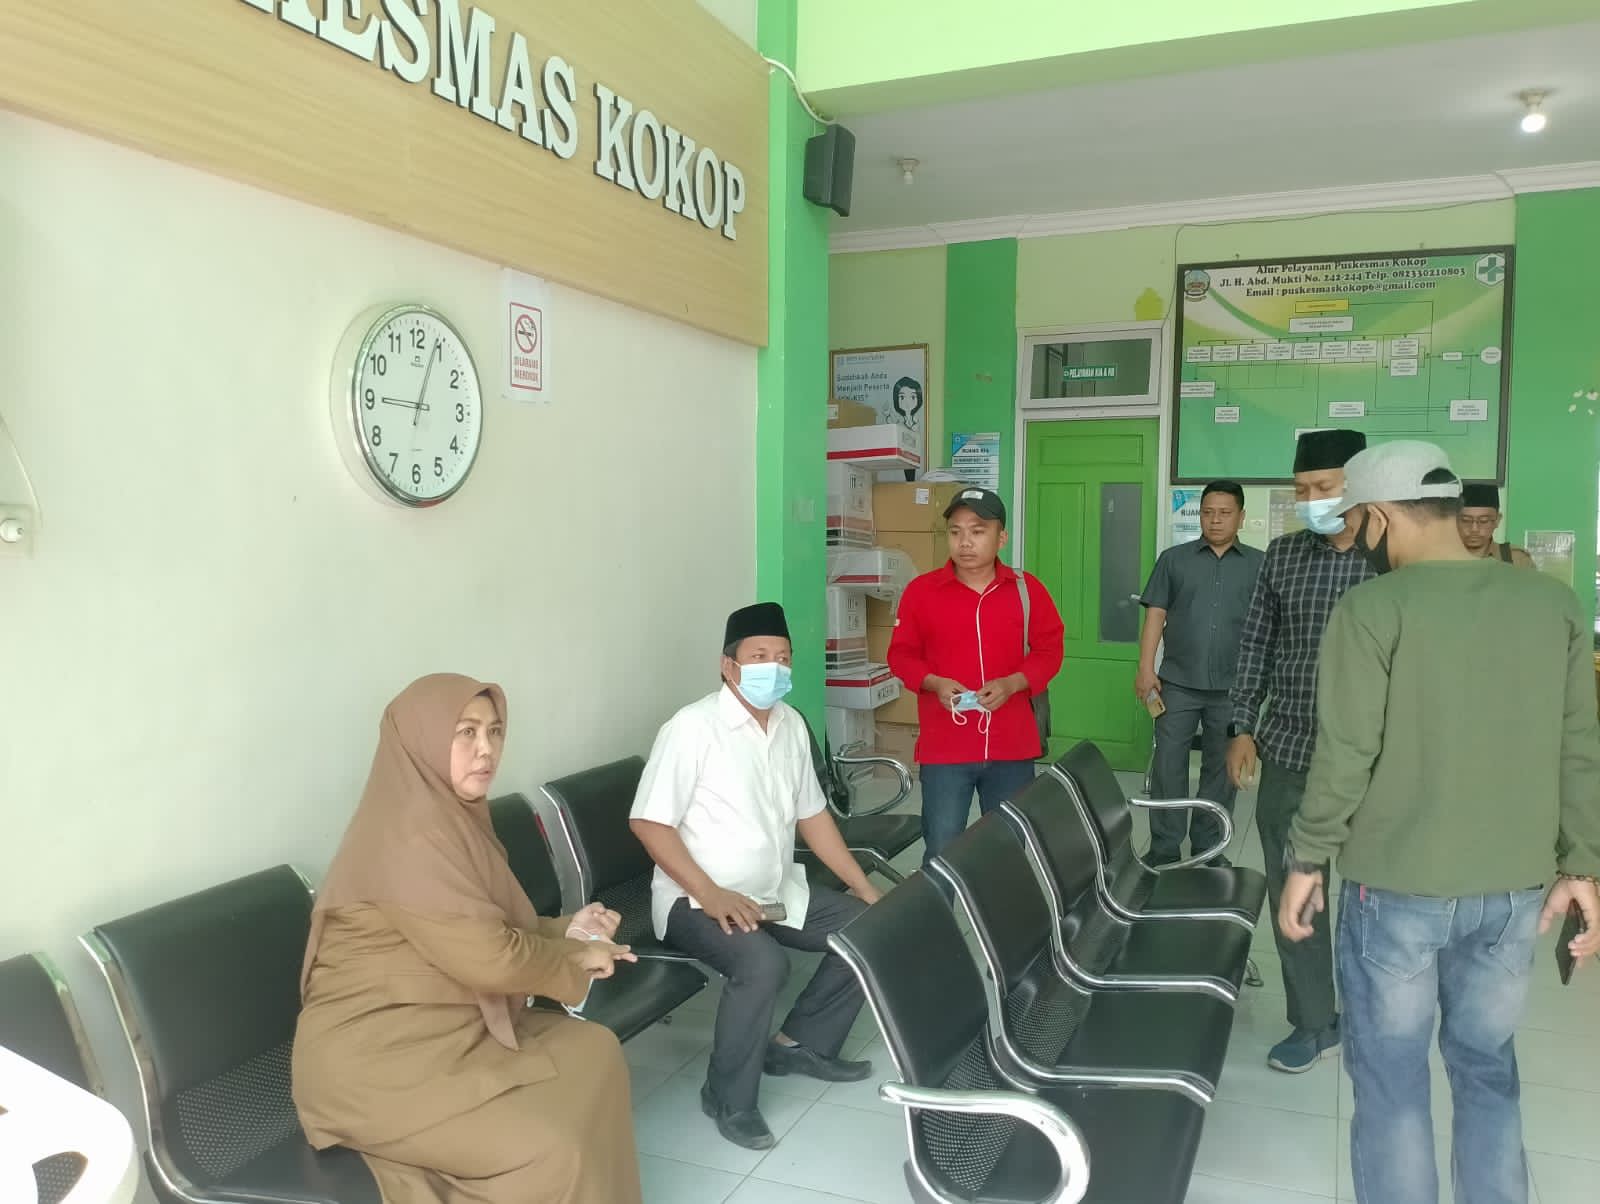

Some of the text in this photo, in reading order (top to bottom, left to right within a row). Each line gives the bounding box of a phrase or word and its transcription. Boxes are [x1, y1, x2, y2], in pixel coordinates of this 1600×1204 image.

[592, 82, 746, 241] KOKOP
[1256, 257, 1427, 275] Alur Pelayanan Puskesmas Kokop
[1219, 279, 1232, 287] Jl.
[1234, 277, 1245, 286] H.
[1246, 277, 1269, 286] Abd.
[1272, 275, 1305, 285] Mukti
[1305, 274, 1321, 283] No.
[1365, 271, 1390, 281] Telp.
[1246, 287, 1274, 297] Email
[388, 331, 401, 354] 11
[409, 328, 425, 350] 12
[436, 342, 442, 362] 1
[370, 354, 387, 376] 10
[449, 369, 459, 389] 2
[364, 388, 375, 410] 9
[455, 403, 464, 423] 3
[371, 425, 382, 447] 8
[449, 435, 459, 454] 4
[388, 452, 399, 474] 7
[433, 456, 443, 477] 5
[411, 464, 421, 485] 6
